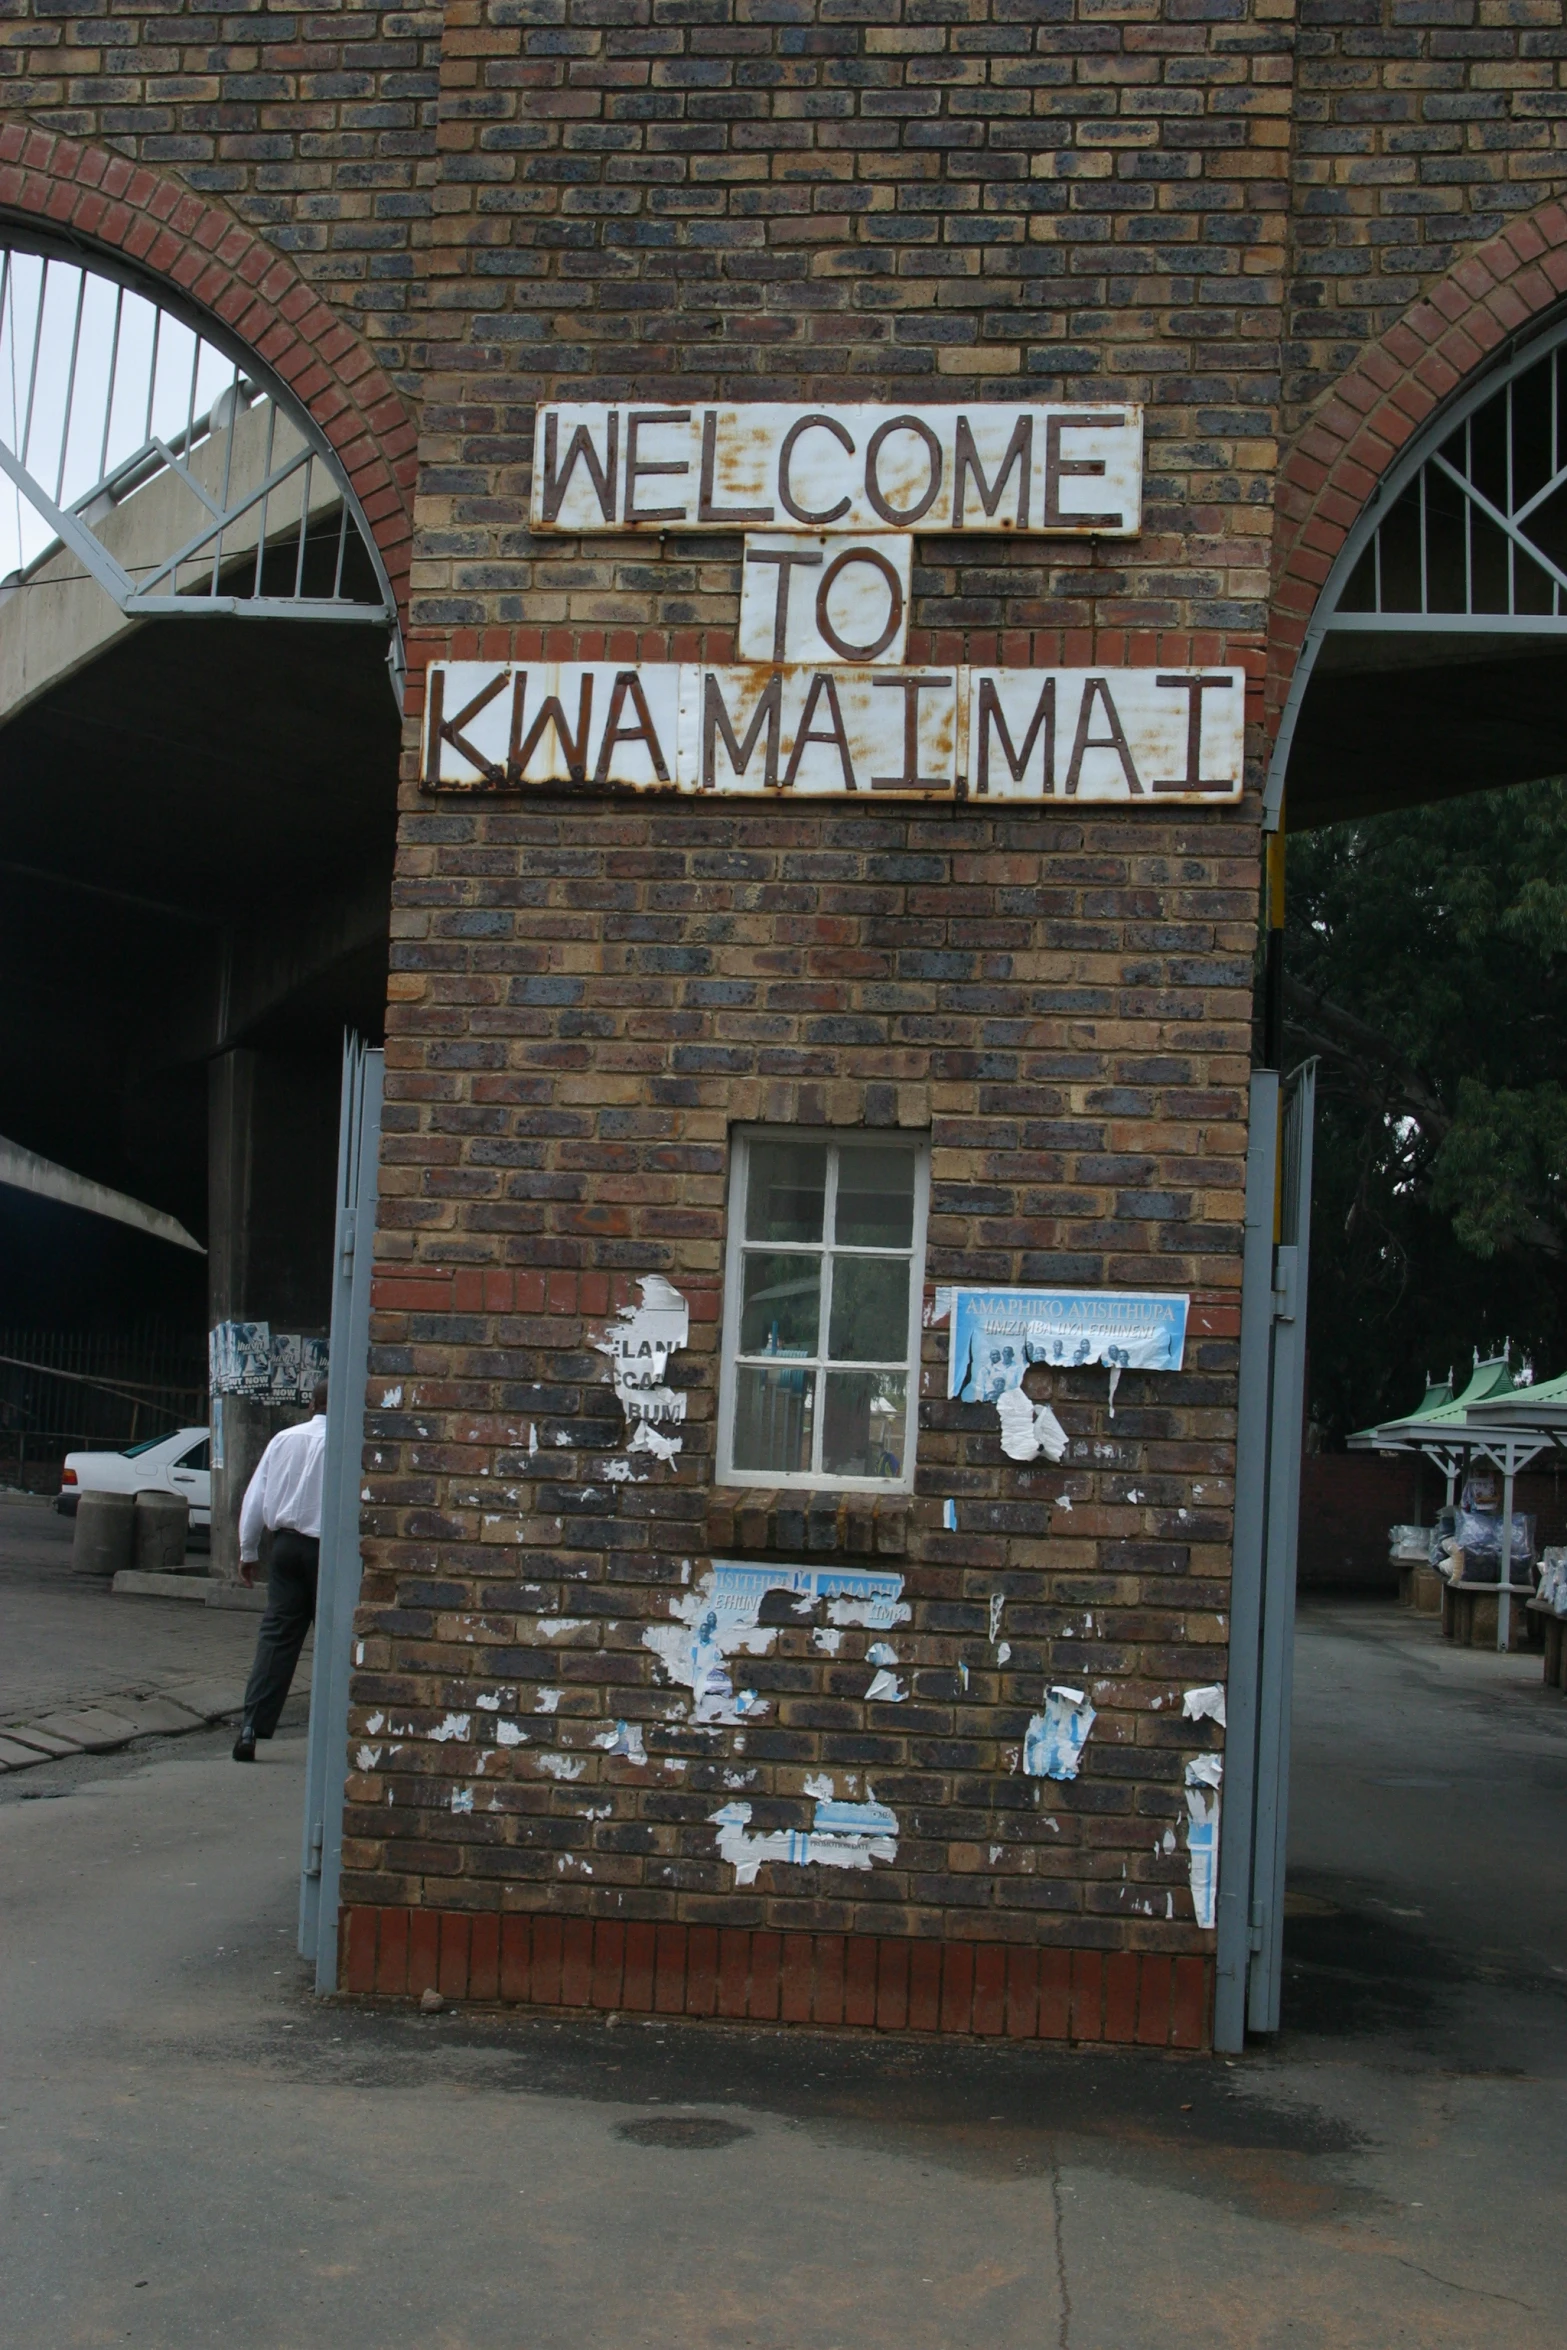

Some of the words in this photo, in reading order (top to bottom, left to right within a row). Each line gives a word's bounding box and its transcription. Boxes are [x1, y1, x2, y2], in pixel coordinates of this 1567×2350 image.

[542, 409, 1126, 529] WELCOME
[746, 546, 905, 662] TO
[425, 669, 671, 785] KWA
[702, 671, 953, 790] MAI
[976, 674, 1235, 793] MAI
[965, 1297, 1064, 1317] AMAPHIKO
[1067, 1301, 1176, 1321] AYISITHUPA
[245, 1376, 269, 1385] NOW
[272, 1389, 296, 1397] NOW
[301, 1392, 313, 1400] OU
[715, 1594, 761, 1611] ETHUN
[810, 1840, 851, 1849] PROMOTION
